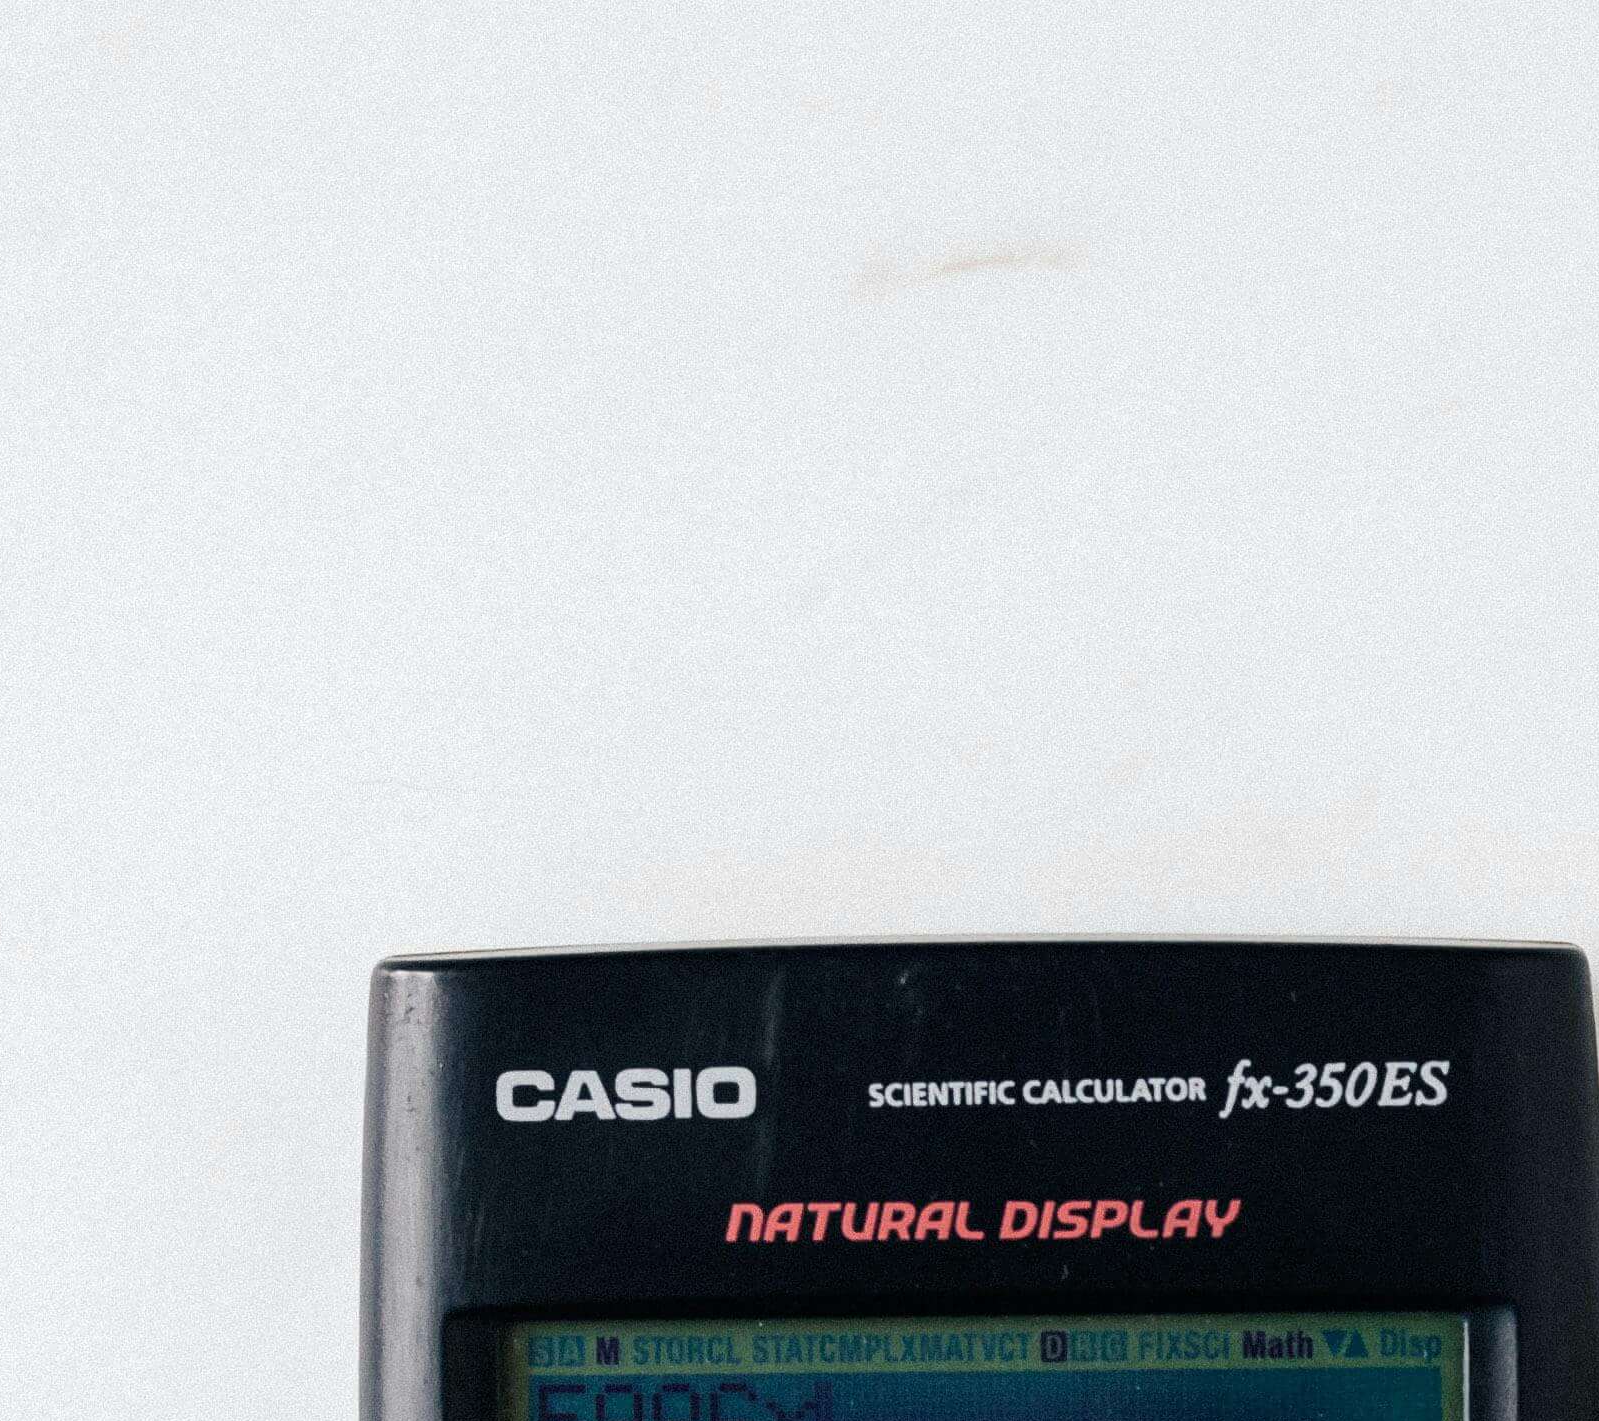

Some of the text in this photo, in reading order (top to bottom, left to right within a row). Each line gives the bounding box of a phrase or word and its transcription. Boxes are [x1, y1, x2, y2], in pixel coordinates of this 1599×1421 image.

[495, 1066, 757, 1123] CASIO
[868, 1058, 1451, 1119] SCIENTIFIC CALCULATOR fx-350ES
[725, 1199, 1241, 1243] NATURAL DISPLAY
[596, 1337, 621, 1365] M
[1040, 1330, 1068, 1363] D
[1242, 1329, 1314, 1360] Math
[1380, 1328, 1443, 1363] Disp
